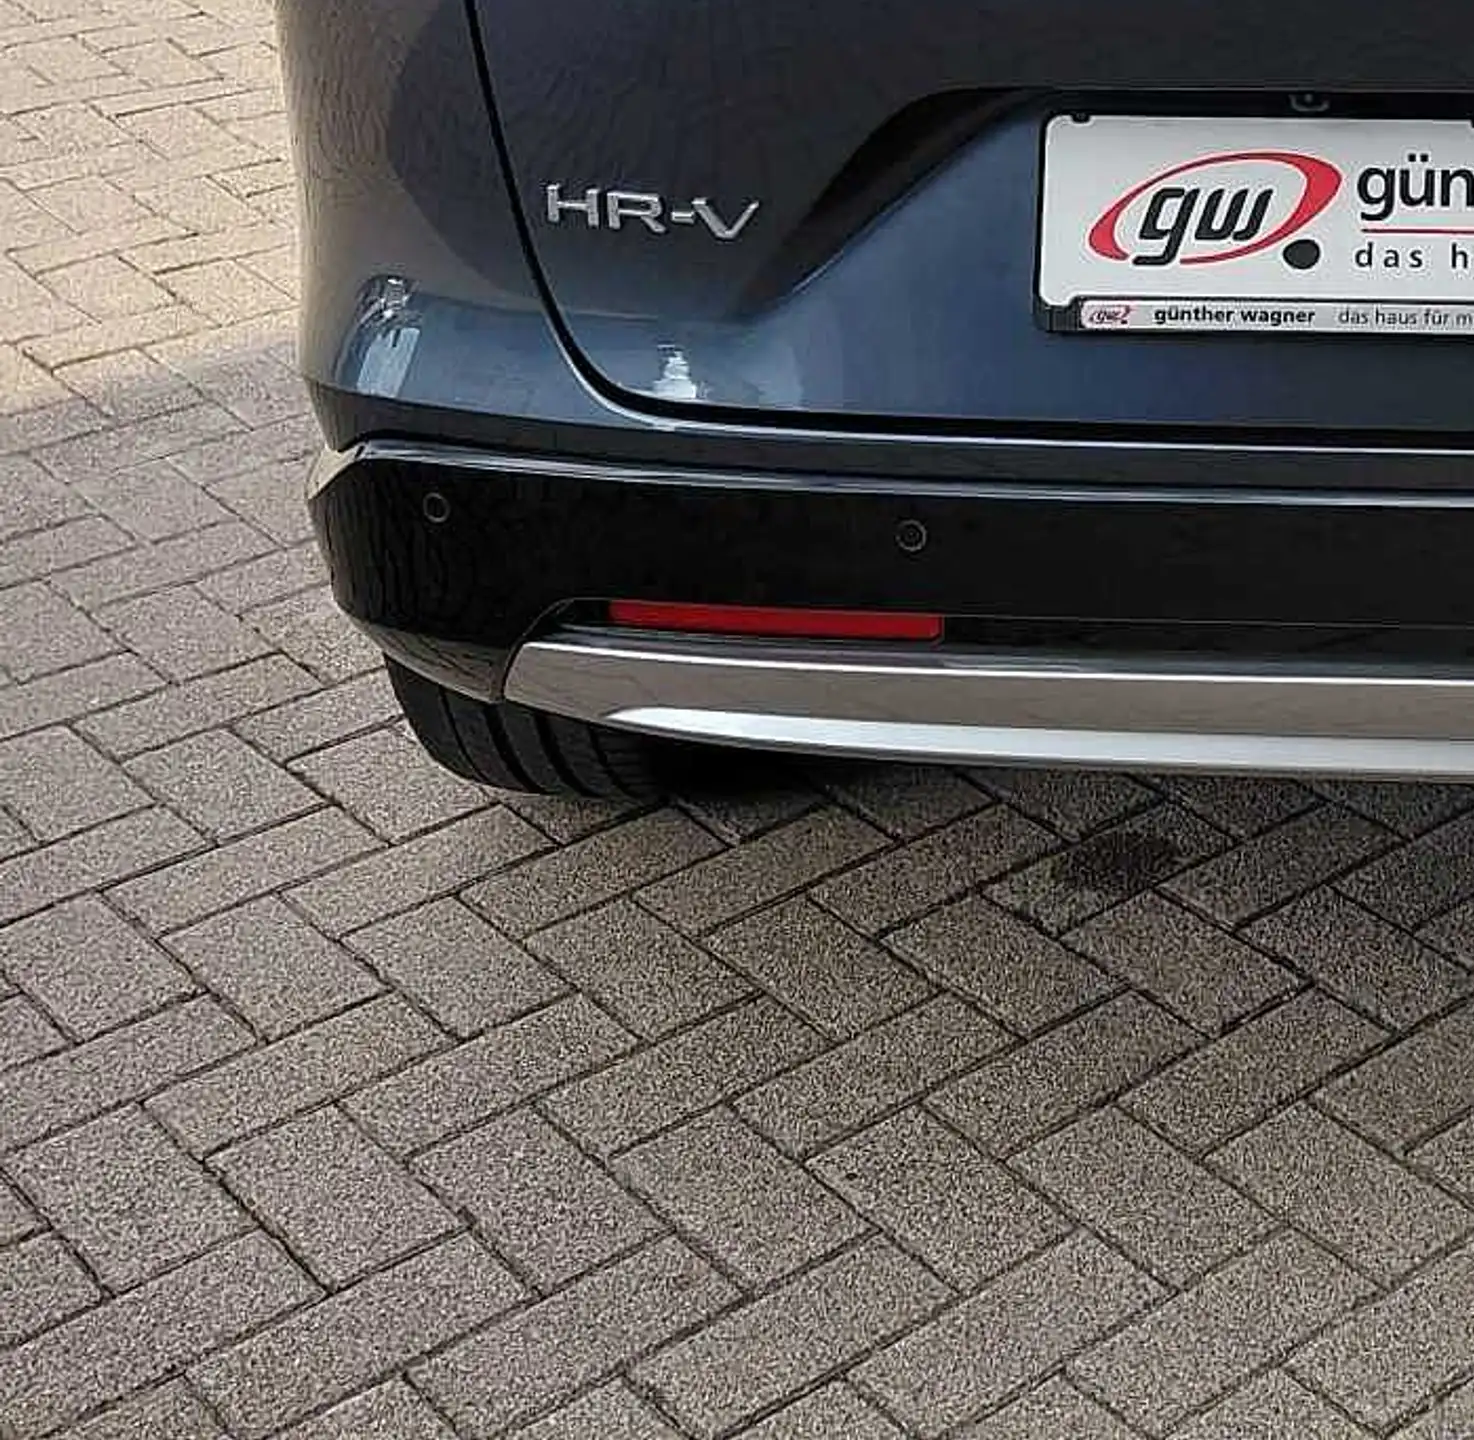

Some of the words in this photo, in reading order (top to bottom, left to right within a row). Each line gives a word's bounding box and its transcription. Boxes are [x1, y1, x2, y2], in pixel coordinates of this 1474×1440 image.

[546, 183, 760, 240] HR-V
[1354, 242, 1424, 269] das
[1153, 304, 1235, 325] günther
[1240, 309, 1316, 326] wagner
[1338, 307, 1368, 324] das
[1374, 307, 1418, 325] haus
[1423, 307, 1450, 326] für
